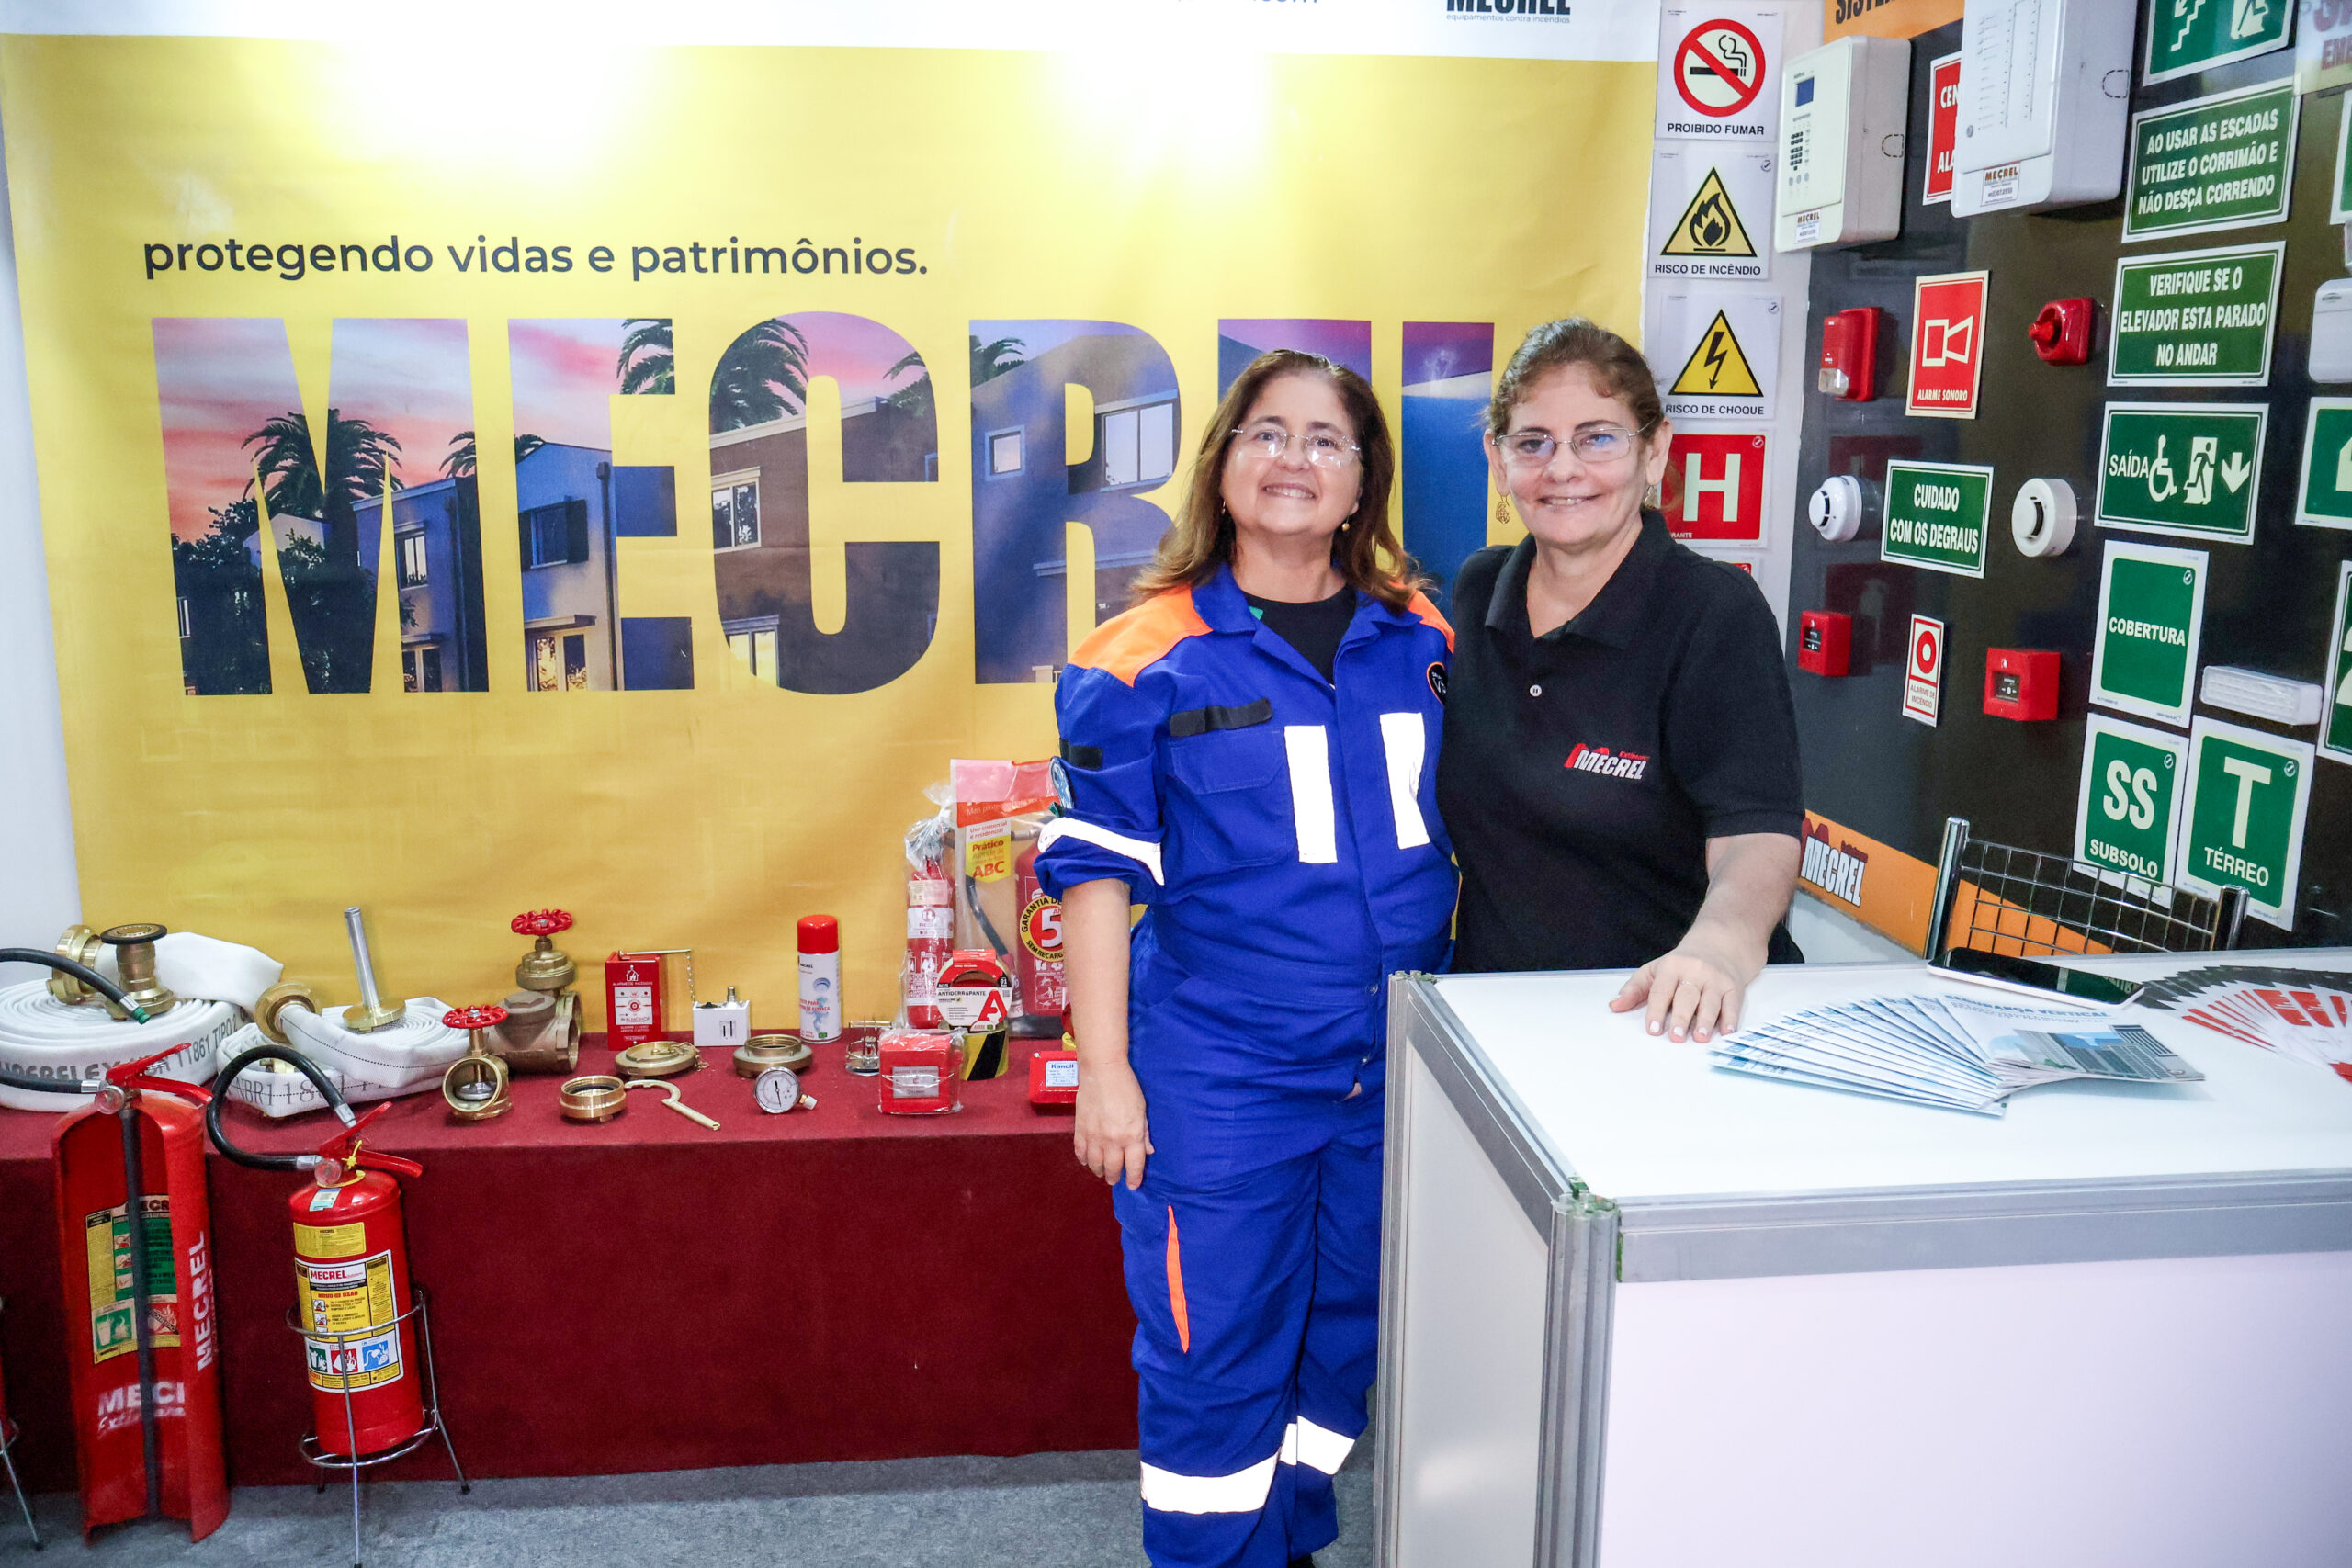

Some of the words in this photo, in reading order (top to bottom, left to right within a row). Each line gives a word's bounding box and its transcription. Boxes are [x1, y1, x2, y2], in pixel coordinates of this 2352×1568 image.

[1446, 14, 1504, 22] equipamentos
[1667, 122, 1722, 135] PROIBIDO
[1724, 124, 1765, 136] FUMAR
[2146, 134, 2164, 155] AO
[2165, 128, 2199, 152] USAR
[2200, 123, 2217, 144] AS
[2220, 108, 2279, 141] ESCADAS
[1984, 166, 2018, 181] MECREL
[2142, 159, 2187, 186] UTILIZE
[2188, 157, 2198, 178] O
[2199, 140, 2267, 175] CORRIMÃO
[2269, 141, 2278, 163] E
[2138, 191, 2163, 216] NÃO
[2165, 186, 2203, 212] DESÇA
[2205, 175, 2275, 205] CORRENDO
[143, 234, 434, 279] protegendo
[447, 236, 573, 274] vidas
[588, 246, 615, 274] e
[631, 236, 929, 282] patrimônios.
[1655, 264, 1688, 275] RISCO
[1691, 264, 1707, 276] DE
[1709, 263, 1761, 276] INCÊNDIO
[2149, 269, 2211, 297] VERIFIQUE
[2213, 267, 2231, 292] SE
[2232, 266, 2243, 291] O
[2120, 308, 2179, 333] ELEVADOR
[2181, 306, 2212, 330] ESTA
[2214, 302, 2267, 329] PARADO
[2155, 344, 2174, 367] NO
[2175, 342, 2218, 366] ANDAR
[1665, 404, 1699, 414] RISCO
[1702, 404, 1716, 414] DE
[1718, 405, 1764, 416] CHOQUE
[1917, 389, 1941, 401] ALARME
[1941, 389, 1968, 402] SONORO
[2109, 449, 2150, 479] SAÍDA
[1682, 452, 1742, 523] H
[1913, 483, 1960, 513] CUIDADO
[1889, 518, 1912, 544] COM
[1914, 521, 1928, 547] OS
[1928, 524, 1980, 555] DEGRAUS
[2109, 616, 2186, 647] COBERTURA
[1910, 684, 1929, 697] ALARME
[1573, 750, 1647, 781] MECREL
[2102, 759, 2158, 830] SS
[2223, 756, 2272, 850] T
[972, 840, 1004, 852] Prático
[2089, 839, 2158, 879] SUBSOLO
[973, 861, 1005, 878] ABC
[1800, 835, 1866, 908] MECREL
[2204, 846, 2269, 887] TÉRREO
[1022, 897, 1049, 932] GARANTIA
[1041, 908, 1063, 948] 5
[1026, 940, 1038, 953] SEM
[310, 1269, 347, 1280] MECREL
[188, 1231, 213, 1371] MECREL
